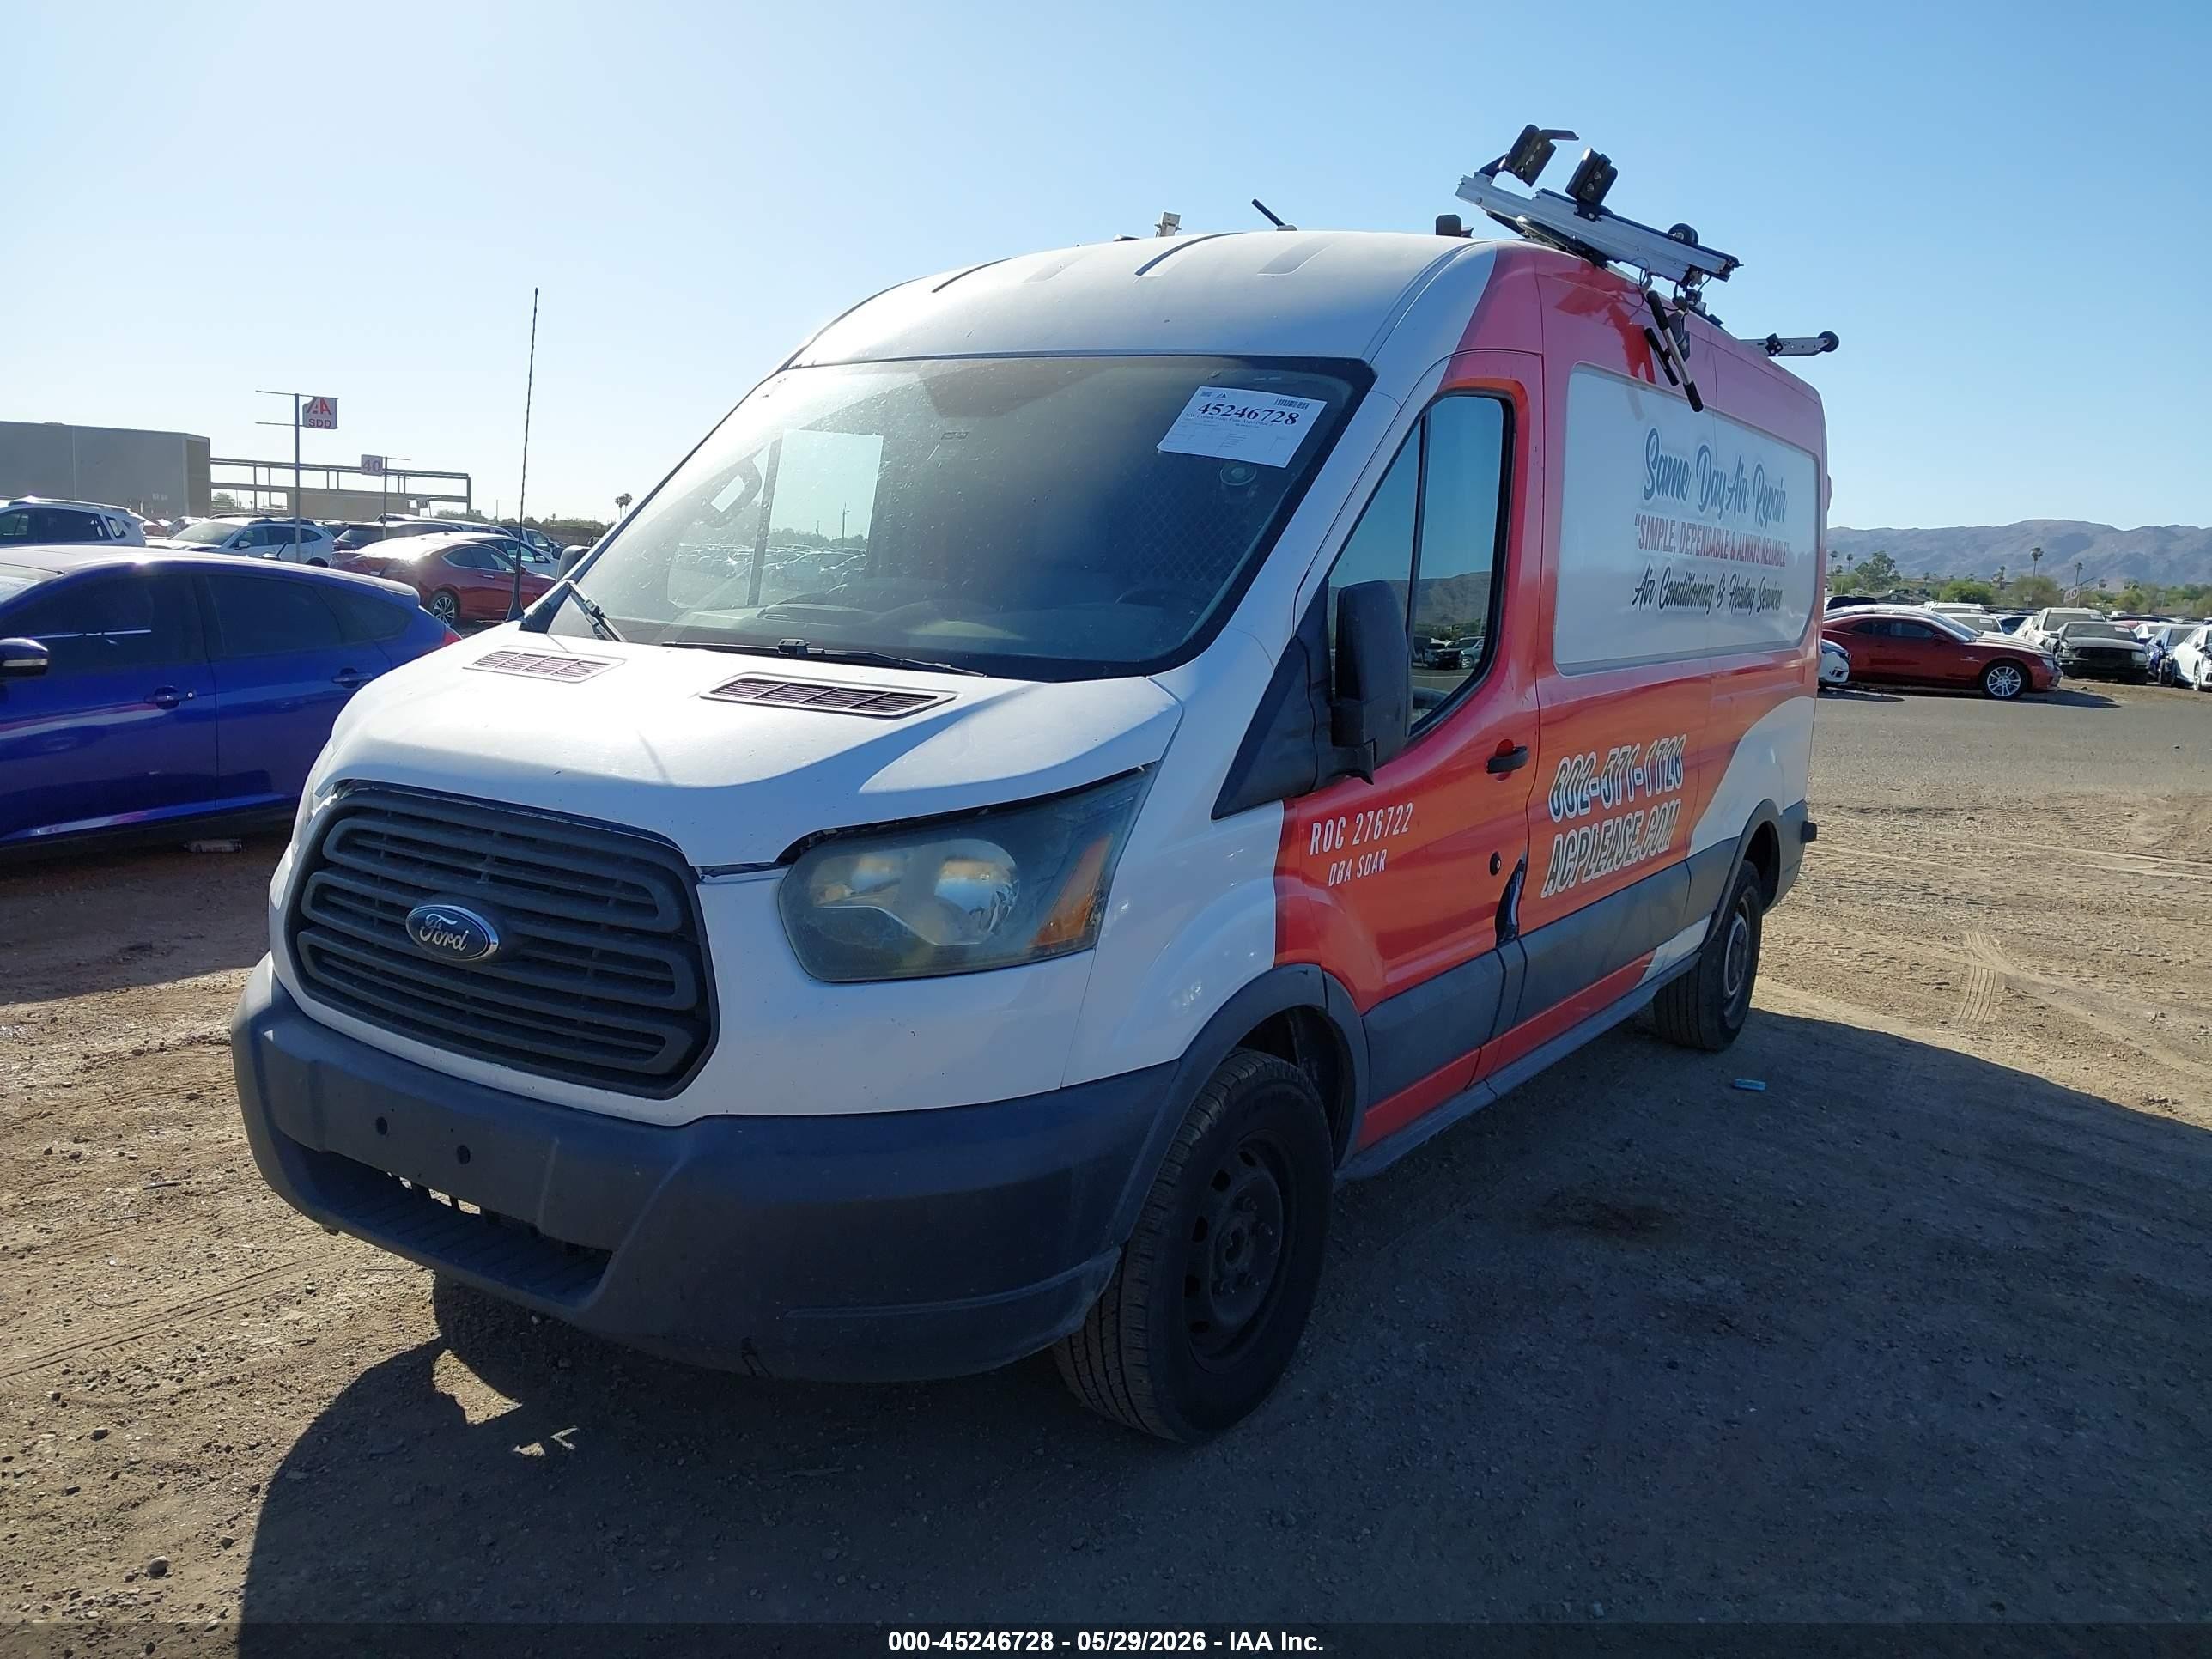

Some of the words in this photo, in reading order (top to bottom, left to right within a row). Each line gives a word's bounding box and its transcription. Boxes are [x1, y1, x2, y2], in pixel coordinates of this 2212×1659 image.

[308, 418, 331, 428] SDD
[1196, 402, 1300, 426] 45246728
[362, 459, 382, 473] 40
[1643, 427, 1691, 502] Same
[1695, 444, 1727, 520] Day
[1726, 455, 1749, 517] Air
[1753, 462, 1788, 527] Repair
[1679, 521, 1730, 560] DEPENDABLE
[1729, 531, 1736, 561] &
[1736, 532, 1761, 563] ALWAYS
[1632, 563, 1656, 611] Air
[1658, 566, 1716, 615] Conditioning
[1717, 572, 1727, 606] &
[1729, 574, 1756, 616] Heating
[1756, 576, 1783, 613] Services
[1309, 817, 1346, 855] ROC
[1352, 802, 1414, 846] 276722
[1328, 858, 1353, 887] DBA
[419, 913, 470, 951] Ford
